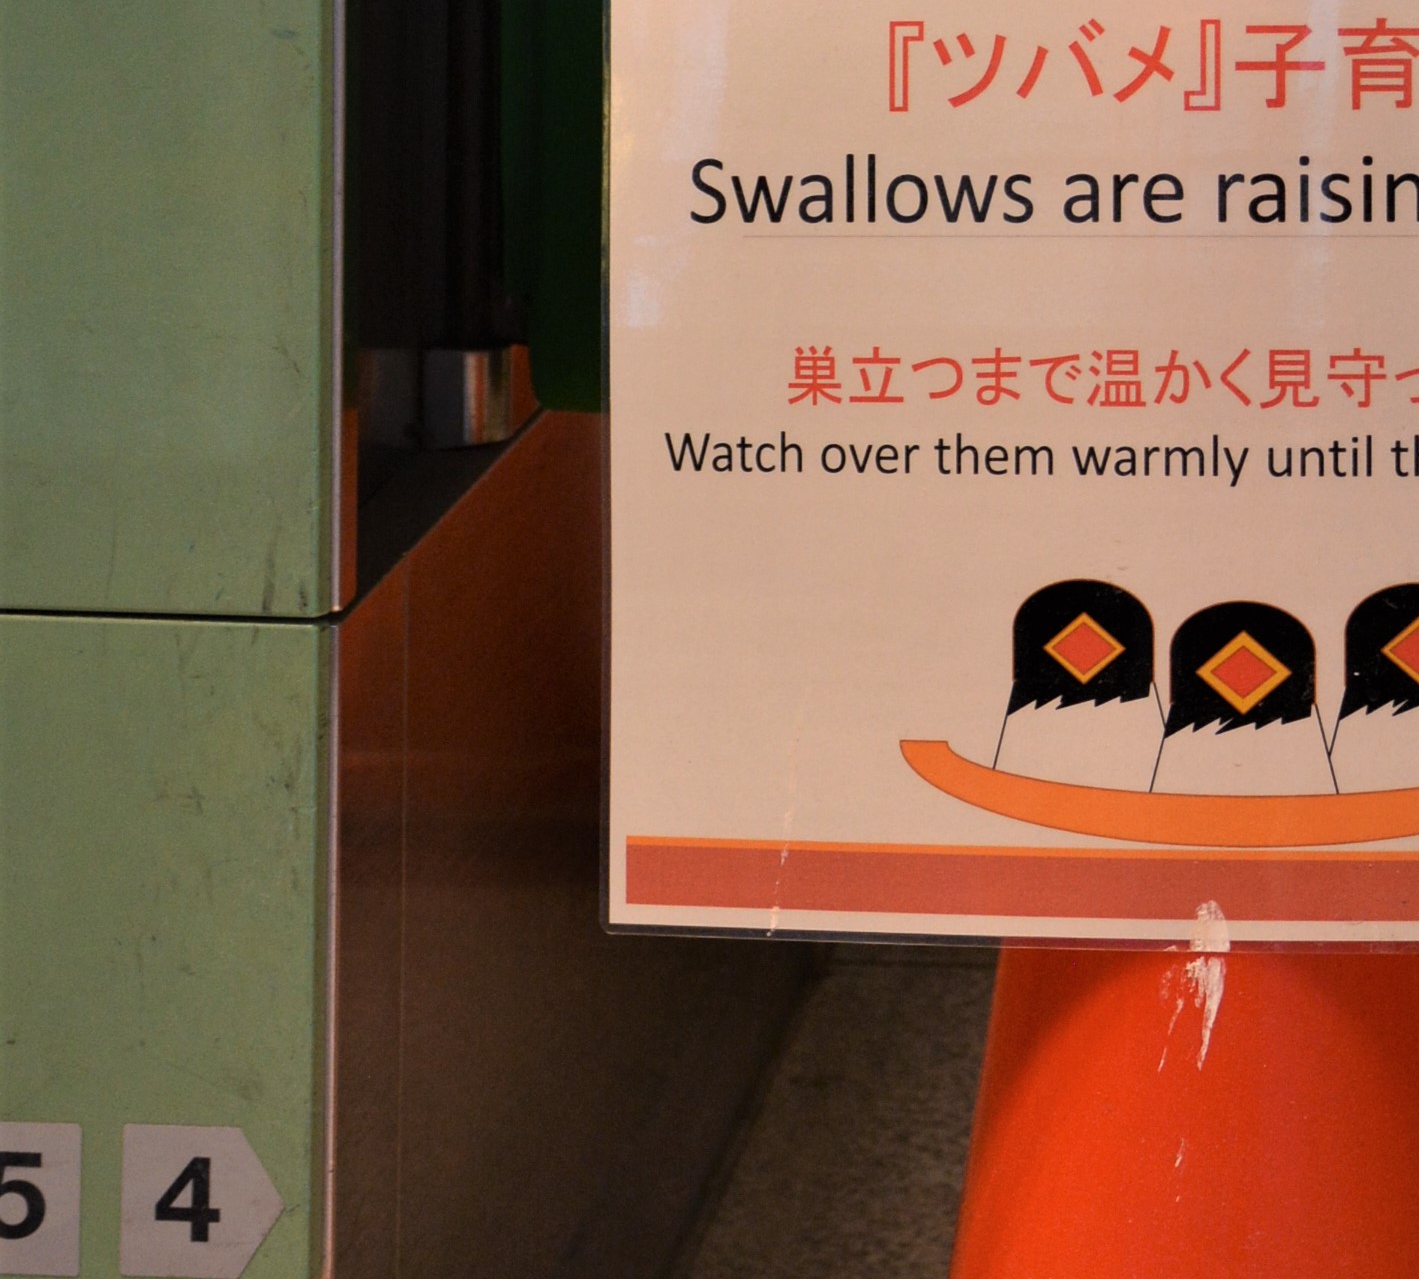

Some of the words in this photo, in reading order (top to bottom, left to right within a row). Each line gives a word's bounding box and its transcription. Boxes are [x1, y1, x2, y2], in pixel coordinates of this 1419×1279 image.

[690, 153, 1035, 225] Swallows
[1064, 173, 1185, 225] are
[664, 431, 804, 473] Watch
[822, 444, 921, 475] over
[936, 433, 1055, 477] them
[1073, 435, 1250, 489] warmly
[1269, 435, 1374, 479] until
[155, 1156, 221, 1243] 4
